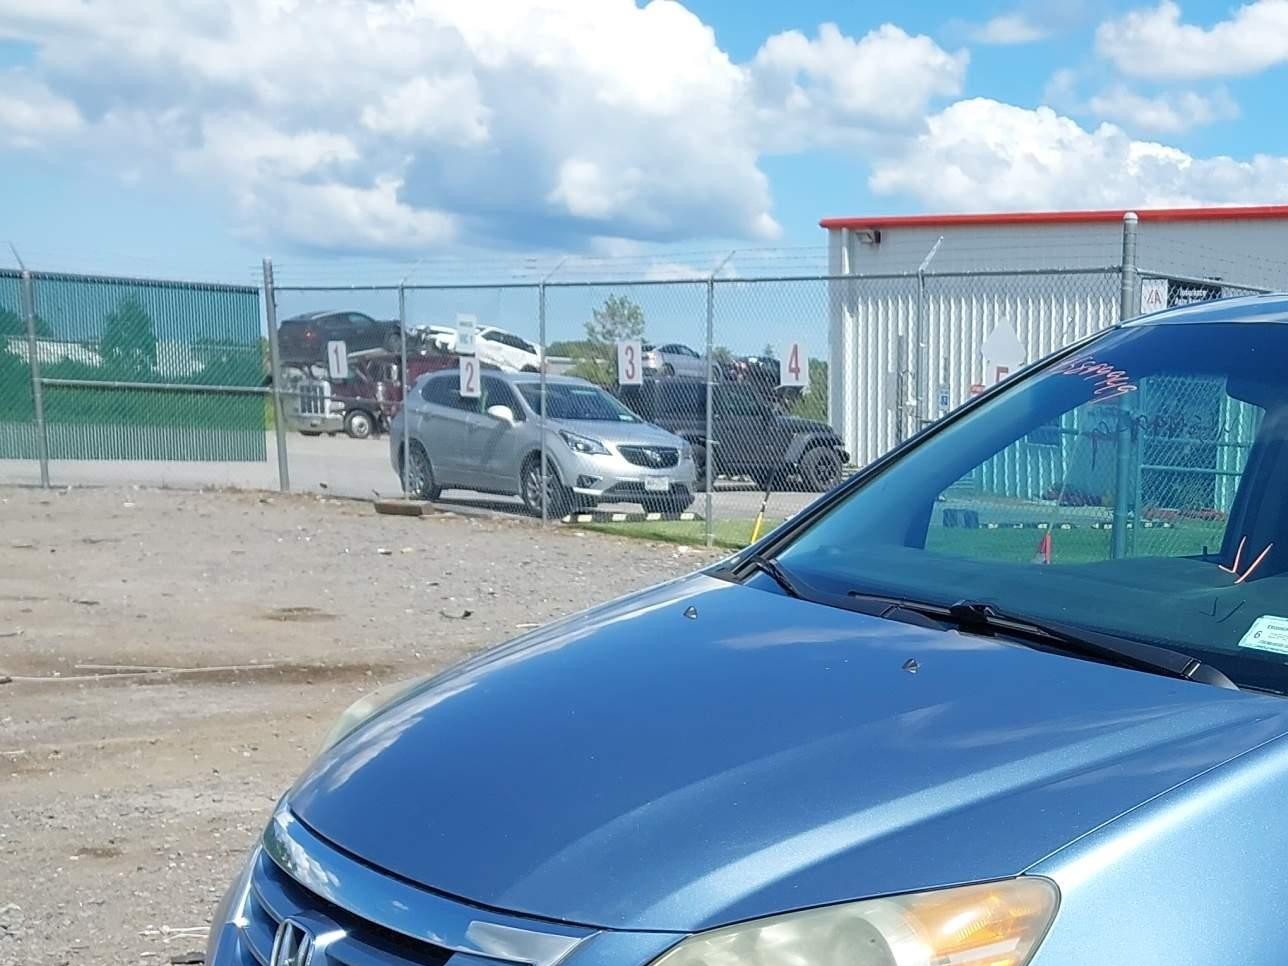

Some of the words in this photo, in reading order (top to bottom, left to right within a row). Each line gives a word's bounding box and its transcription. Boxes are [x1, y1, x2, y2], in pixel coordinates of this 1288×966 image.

[333, 345, 342, 374] 1
[625, 346, 635, 379] 3
[788, 343, 801, 380] 4
[465, 362, 474, 392] 2
[1253, 630, 1262, 638] 6
